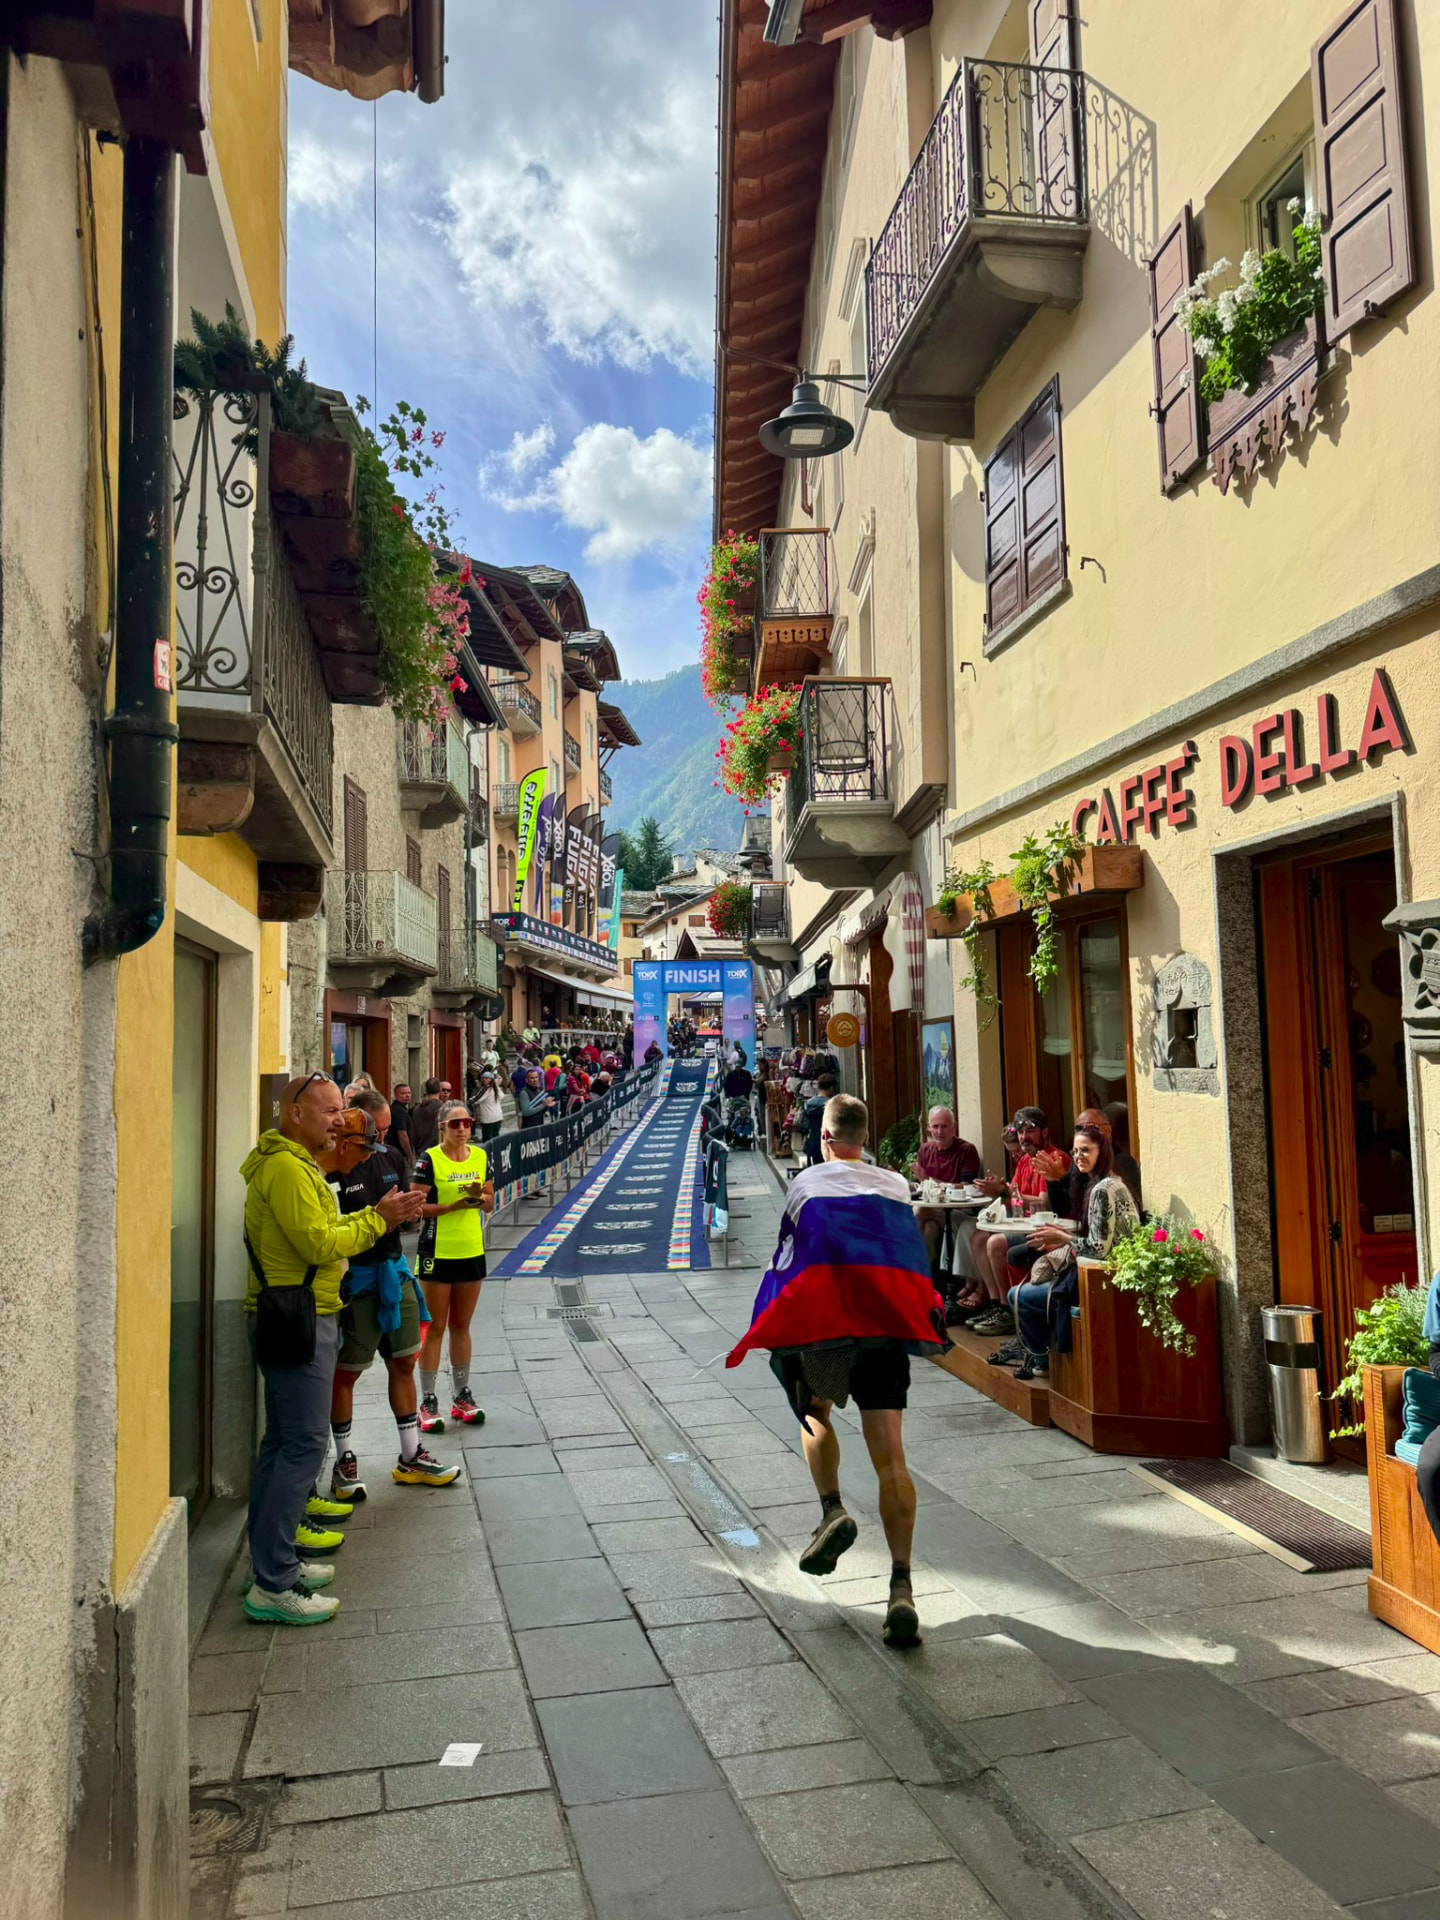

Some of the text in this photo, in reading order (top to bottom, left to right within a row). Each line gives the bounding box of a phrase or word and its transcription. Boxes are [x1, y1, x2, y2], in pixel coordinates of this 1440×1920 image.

[1219, 668, 1412, 808] DELLA
[553, 816, 563, 860] TORX
[565, 825, 582, 885] FUGA
[577, 835, 592, 891] FUGA
[601, 852, 616, 888] TORX
[664, 969, 721, 984] FINISH
[345, 1183, 365, 1194] FUGA
